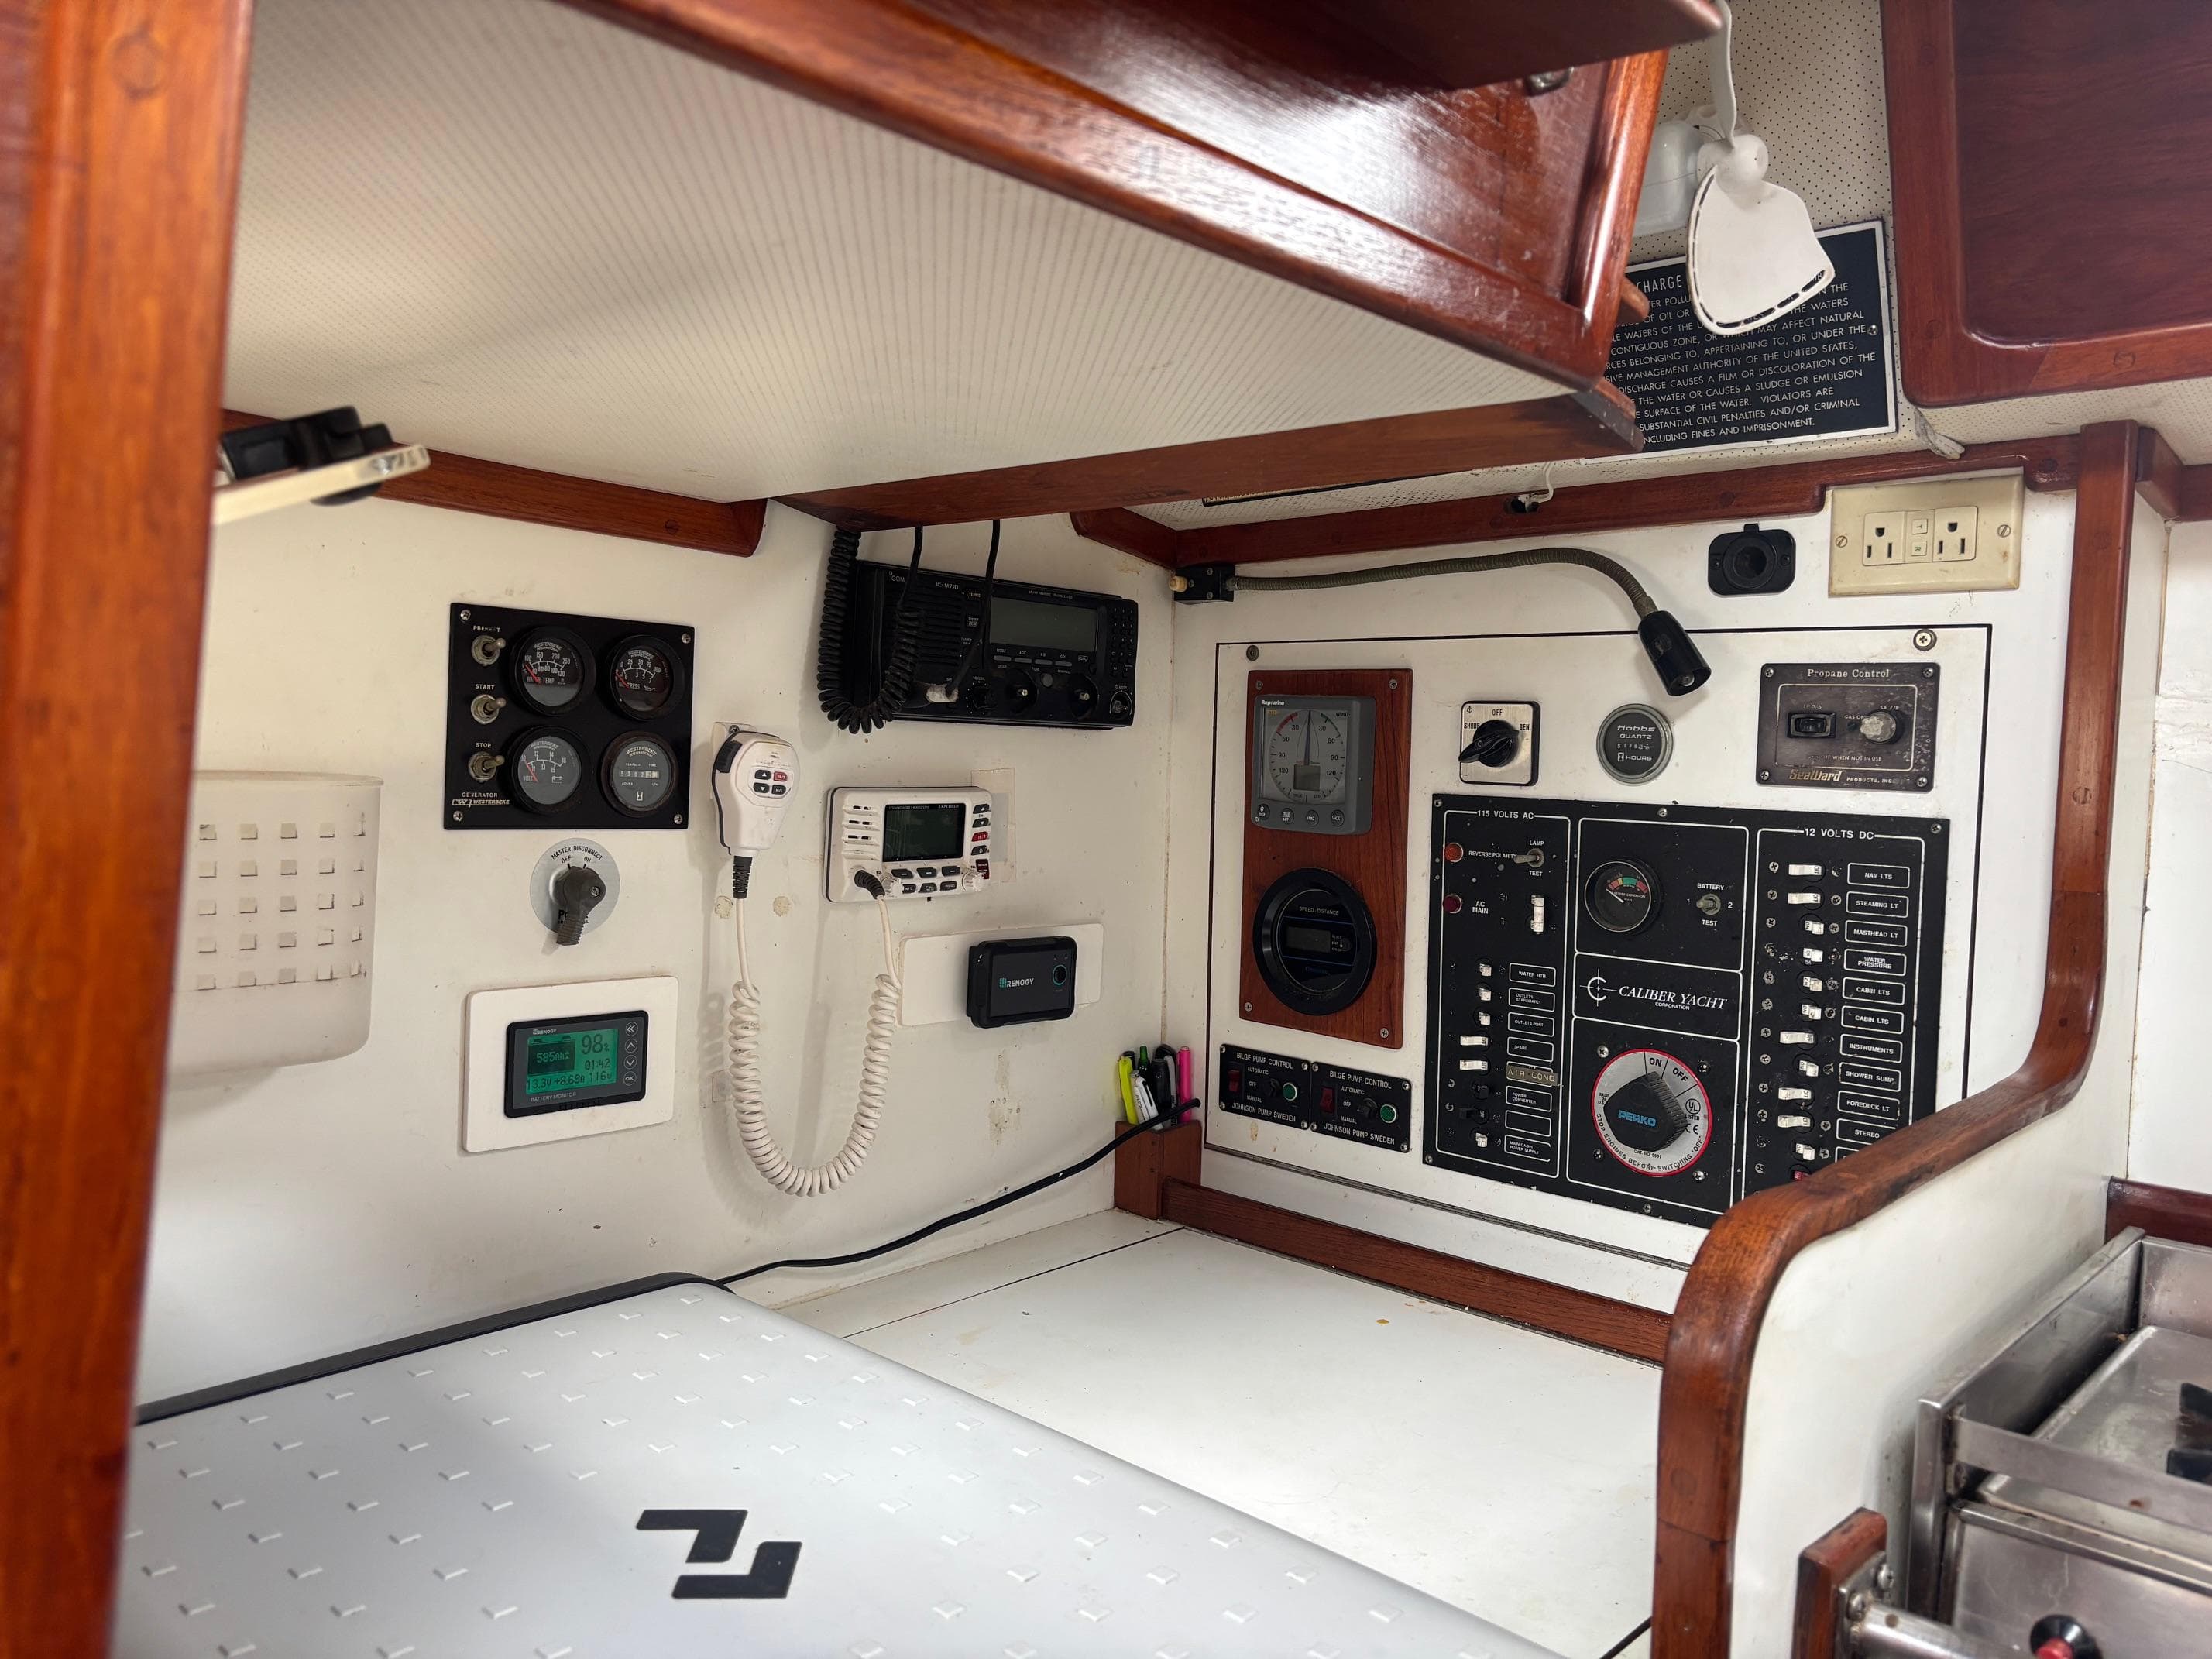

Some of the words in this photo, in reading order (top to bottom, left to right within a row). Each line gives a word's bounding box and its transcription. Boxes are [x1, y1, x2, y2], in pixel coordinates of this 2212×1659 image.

[1630, 352, 1681, 366] BELONGING
[1685, 350, 1699, 359] TO,
[1704, 339, 1768, 358] APPERTAINING
[1773, 337, 1788, 345] TO,
[1793, 334, 1806, 342] OR
[1811, 328, 1844, 340] UNDER
[1848, 325, 1866, 334] THE
[1627, 365, 1688, 380] MANAGEMENT
[1693, 357, 1741, 371] AUTHORITY
[1746, 355, 1758, 363] OF
[1763, 352, 1779, 361] THE
[1784, 347, 1818, 358] UNITED
[1822, 341, 1857, 352] STATES,
[1671, 376, 1703, 387] CAUSES
[1719, 373, 1737, 382] FILM
[1741, 369, 1754, 378] OR
[1759, 356, 1835, 376] DISCOLORATION
[1839, 356, 1853, 365] OF
[1857, 352, 1876, 362] THE
[1638, 397, 1654, 405] THE
[1657, 393, 1685, 402] WATER
[1706, 385, 1740, 397] CAUSES
[1756, 379, 1791, 390] SLUDGE
[1795, 376, 1808, 385] OR
[1813, 369, 1862, 383] EMULSION
[1644, 407, 1681, 417] SURFACE
[1685, 404, 1696, 413] OF
[1700, 402, 1716, 411] THE
[1719, 398, 1752, 407] WATER.
[1760, 390, 1811, 403] VIOLATORS
[1816, 387, 1833, 397] ARE
[1640, 415, 1693, 431] SUBSTANTIAL
[1697, 415, 1718, 424] CIVIL
[1722, 410, 1765, 421] PENALTIES
[1770, 404, 1810, 417] AND/OR
[1814, 398, 1860, 410] CRIMINAL
[1692, 429, 1715, 438] FINES
[1719, 427, 1739, 435] AND
[1743, 417, 1815, 433] IMPRISONMENT.
[1808, 669, 1848, 678] Propane
[1821, 829, 1853, 838] VOLTS
[1859, 831, 1874, 840] DC
[551, 847, 571, 860] MASTER
[573, 846, 603, 863] DISCONNECT
[561, 855, 572, 864] OFF
[1858, 958, 1891, 969] PRESSURE
[1007, 978, 1034, 987] RENOGY
[1620, 986, 1676, 1002] CALIBER
[1680, 993, 1727, 1009] YACHT
[1850, 1043, 1894, 1054] INSTRUMENTS
[1237, 1052, 1251, 1060] BILGE
[1269, 1059, 1293, 1069] CONTROL
[1650, 1058, 1662, 1066] ON
[1248, 1066, 1269, 1075] AUTOMATIC
[1673, 1067, 1688, 1081] OFF
[1846, 1071, 1873, 1080] SHOWER
[1330, 1070, 1345, 1080] BILGE
[1348, 1074, 1362, 1083] PUMP
[1365, 1077, 1391, 1089] CONTROL
[1341, 1086, 1365, 1094] AUTOMATIC
[1232, 1103, 1256, 1113] JOHNSON
[1258, 1108, 1272, 1116] PUMP
[1273, 1111, 1296, 1121] SWEDEN
[1846, 1100, 1879, 1110] FOREDECK
[1618, 1110, 1657, 1128] PERKO
[1324, 1123, 1350, 1135] JOHNSON
[1353, 1129, 1368, 1139] PUMP
[1370, 1133, 1394, 1145] SWEDEN
[1855, 1129, 1880, 1138] STEREO
[1597, 1114, 1606, 1131] STOP
[1604, 1131, 1629, 1159] ENGINES
[1628, 1158, 1656, 1170] BEFORE
[1657, 1154, 1692, 1171] SWITCHING
